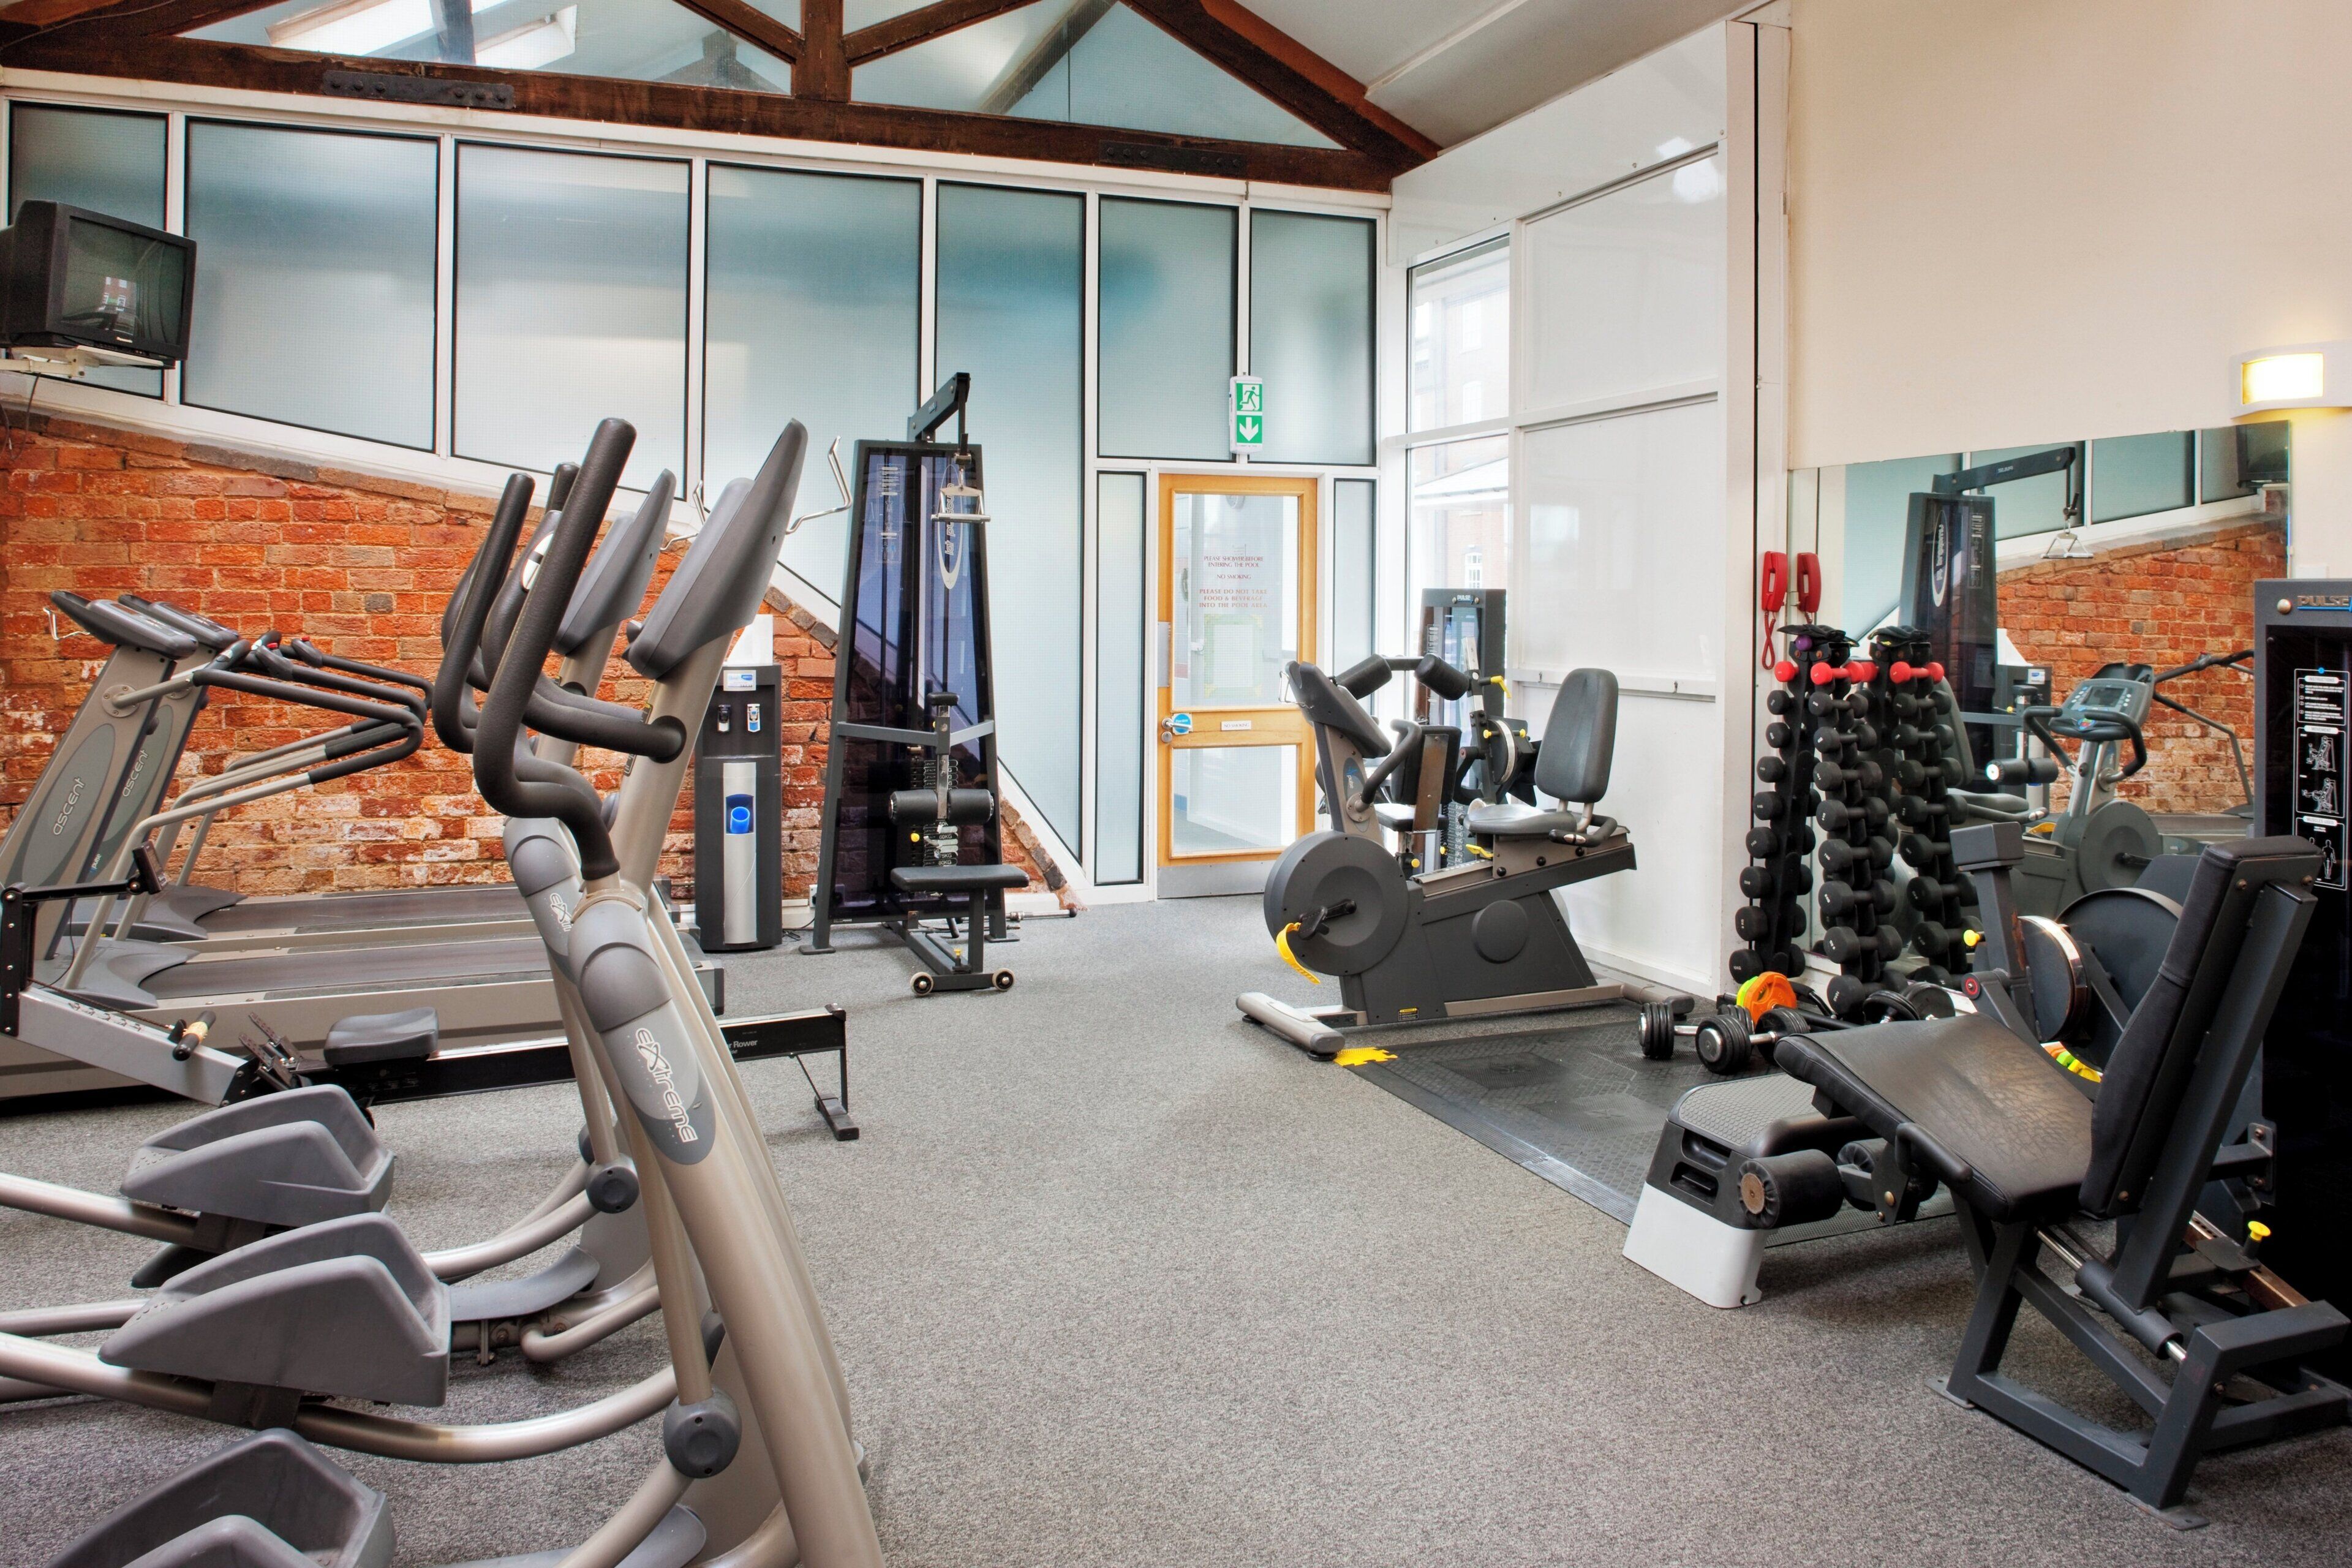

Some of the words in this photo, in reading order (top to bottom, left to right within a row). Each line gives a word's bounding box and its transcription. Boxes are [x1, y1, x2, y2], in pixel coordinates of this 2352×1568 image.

[945, 540, 954, 556] lat
[2297, 595, 2350, 606] PULSE
[122, 749, 149, 797] ascent
[53, 776, 86, 835] ascent
